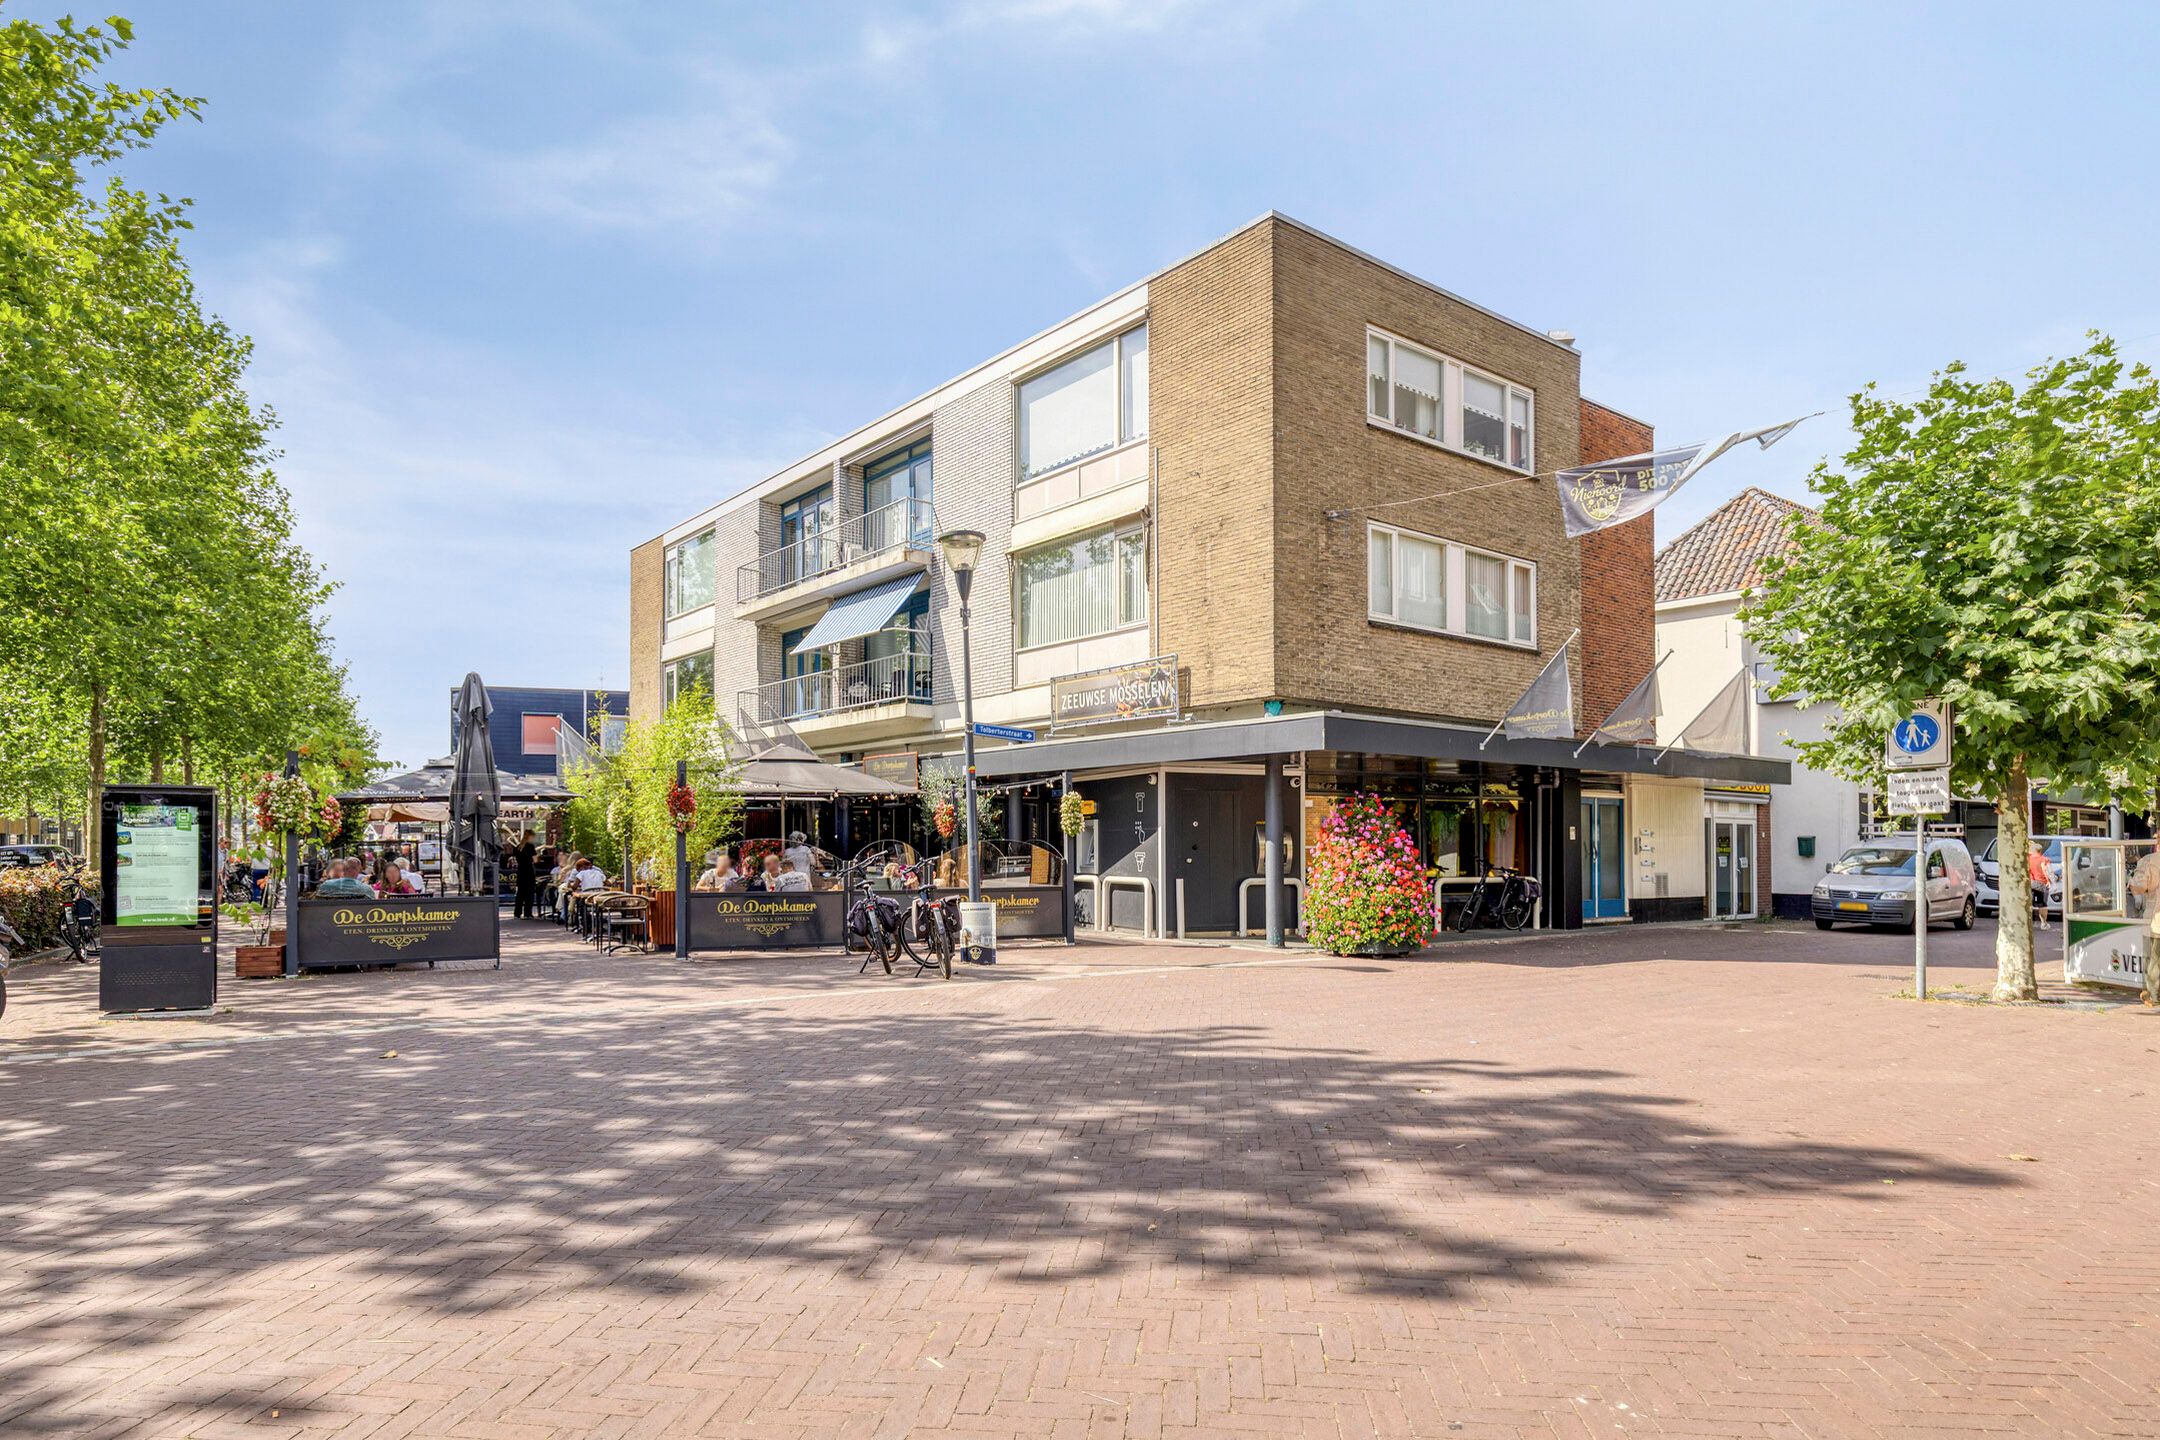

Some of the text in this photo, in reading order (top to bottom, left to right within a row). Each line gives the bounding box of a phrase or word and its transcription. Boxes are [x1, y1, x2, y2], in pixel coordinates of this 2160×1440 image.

[1637, 468, 1656, 480] DIT
[1639, 474, 1669, 493] 500
[1061, 680, 1166, 710] ZEEUWSE MOSSELEN
[980, 726, 1023, 738] Tolberterstraat
[333, 906, 460, 925] De Dorpskamer
[717, 898, 818, 915] De Dorpskamer
[2122, 954, 2144, 974] VEL
